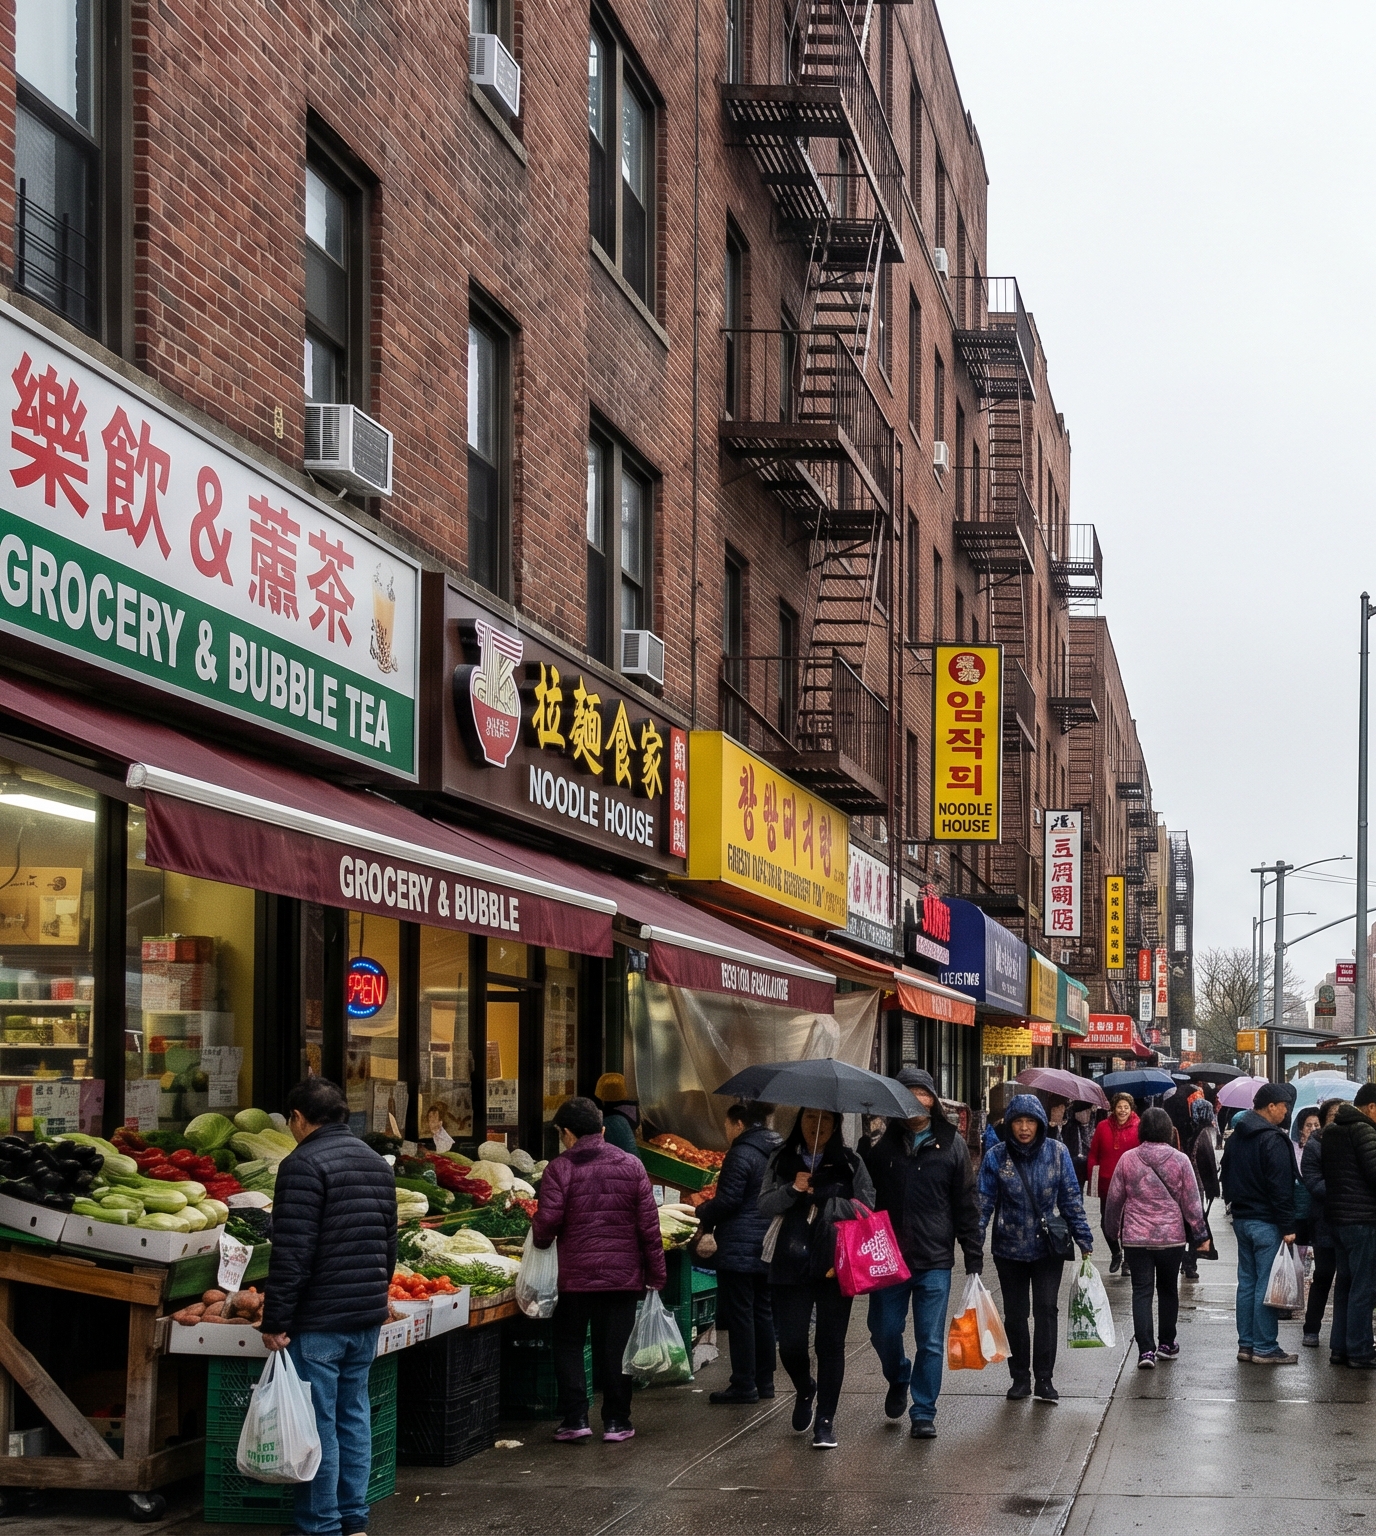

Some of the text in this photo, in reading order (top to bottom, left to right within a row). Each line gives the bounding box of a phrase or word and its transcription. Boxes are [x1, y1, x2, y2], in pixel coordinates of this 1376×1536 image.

[190, 466, 233, 587] &
[1, 534, 391, 753] GROCERY & BUBBLE TEA
[532, 661, 663, 799] 拉麵食家
[529, 764, 654, 847] NOODLE HOUSE
[939, 803, 992, 816] NOODLE
[942, 819, 990, 833] HOUSE
[339, 855, 520, 932] GROCERY & BUBBLE
